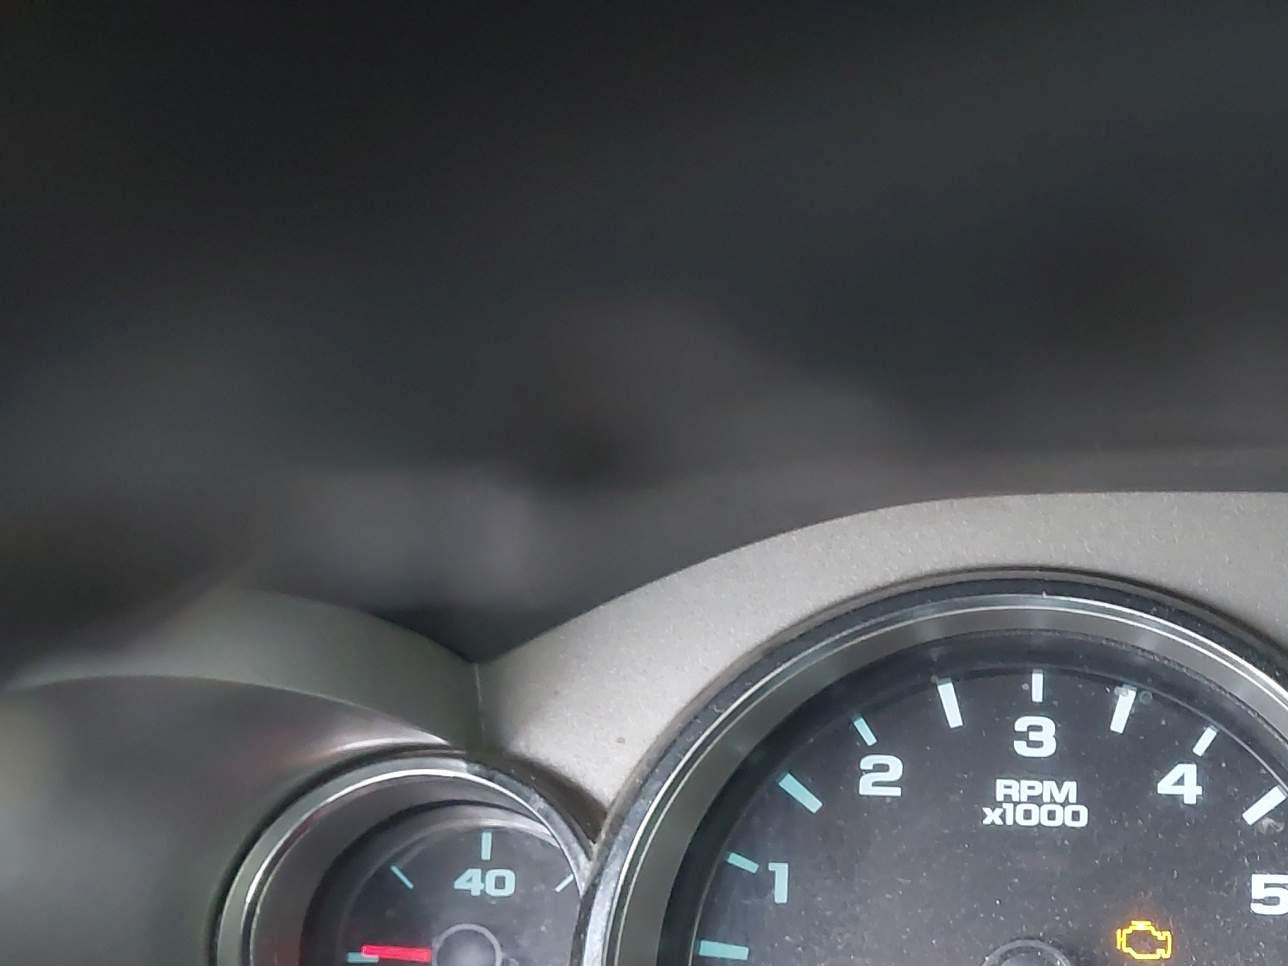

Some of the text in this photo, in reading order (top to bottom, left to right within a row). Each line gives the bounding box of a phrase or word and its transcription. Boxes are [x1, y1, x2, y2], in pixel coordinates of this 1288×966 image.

[1013, 716, 1057, 757] 3
[859, 754, 904, 797] 2
[995, 779, 1077, 803] RPM
[1157, 763, 1203, 805] 4
[982, 804, 1088, 828] x1000
[453, 868, 516, 897] 40
[768, 862, 789, 904] 1
